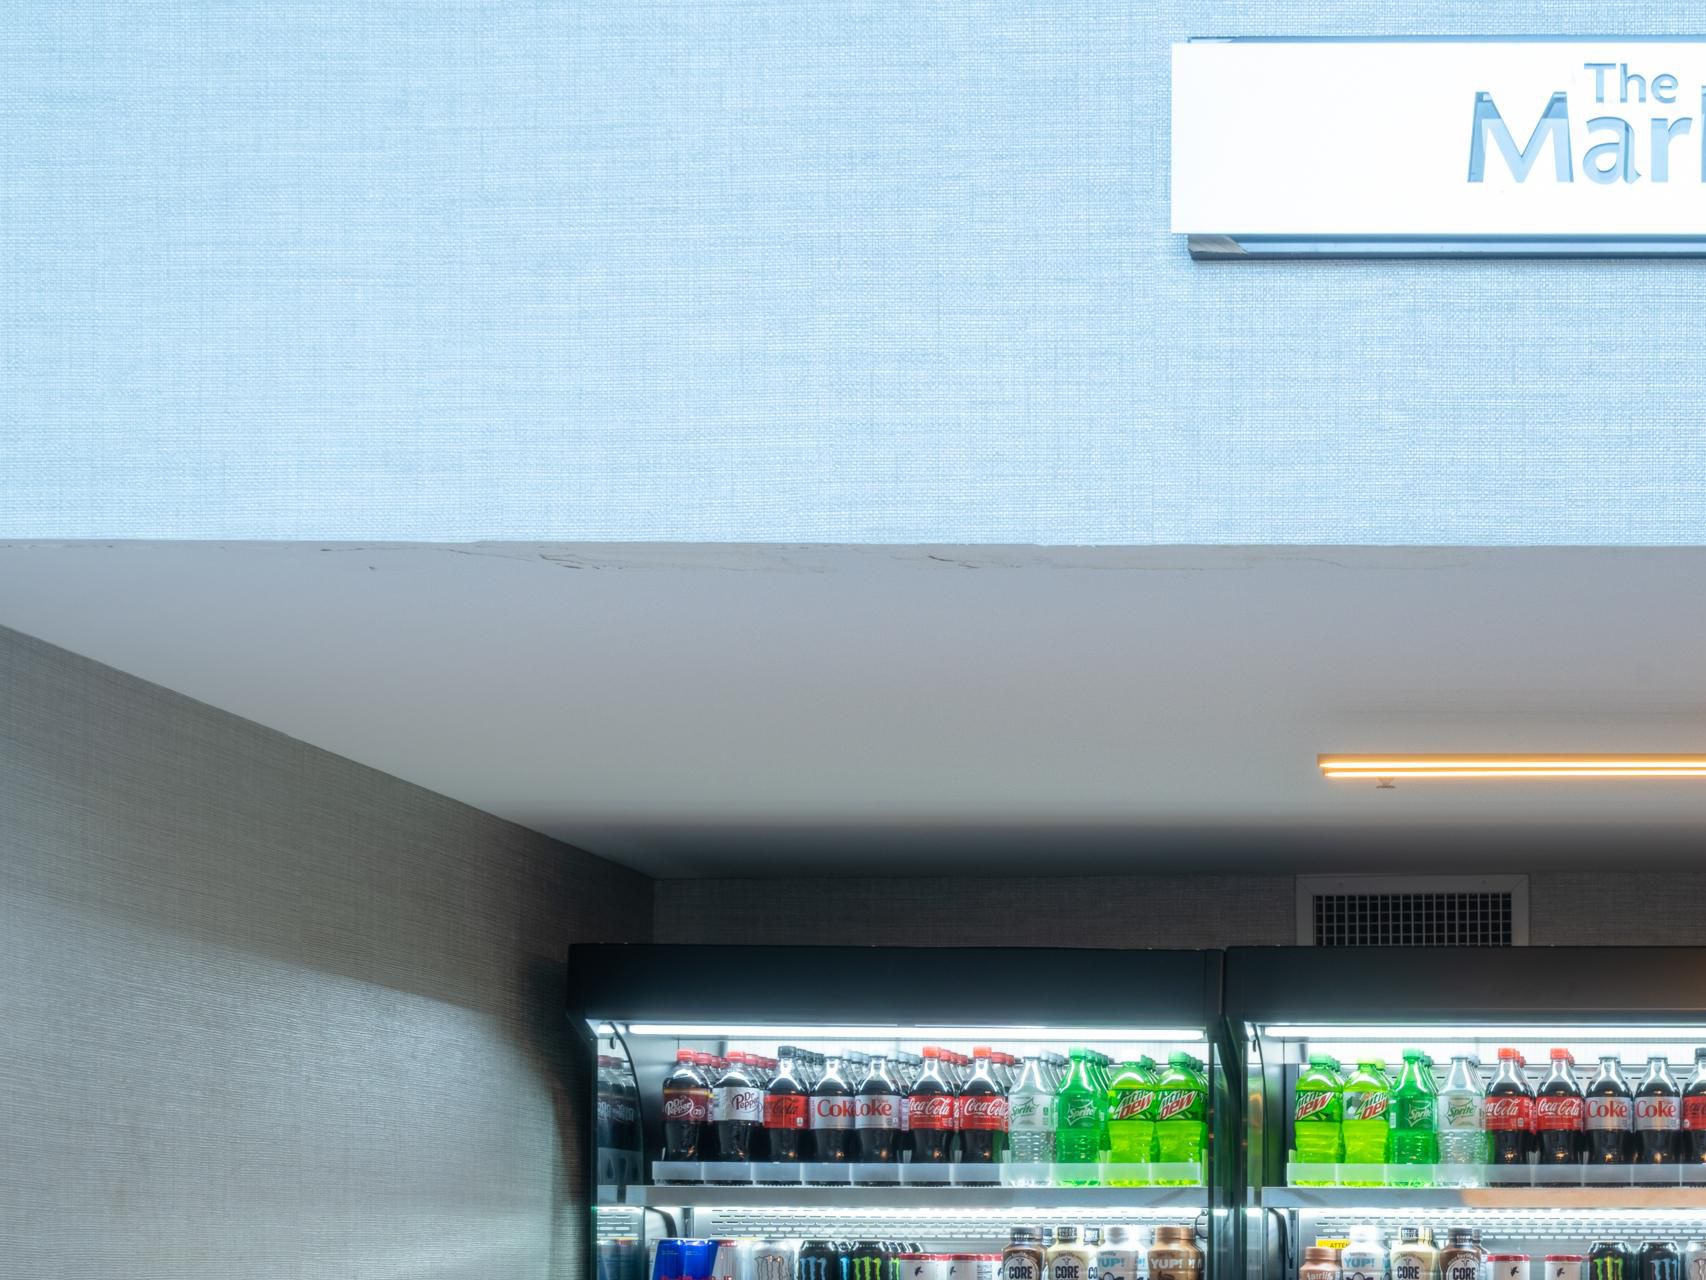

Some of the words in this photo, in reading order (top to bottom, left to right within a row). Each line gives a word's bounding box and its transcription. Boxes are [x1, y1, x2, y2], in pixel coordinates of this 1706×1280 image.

[1583, 61, 1679, 106] The
[1010, 1102, 1037, 1118] Sprite
[1068, 1104, 1095, 1120] Sprite
[1587, 1100, 1628, 1118] Coke
[1635, 1100, 1677, 1118] Coke
[1150, 1258, 1183, 1270] YUP!
[1345, 1256, 1375, 1268] YUP!
[1008, 1266, 1033, 1280] CORE
[1055, 1265, 1080, 1279] CORE
[1396, 1266, 1420, 1280] CORE
[1452, 1267, 1476, 1280] CORE
